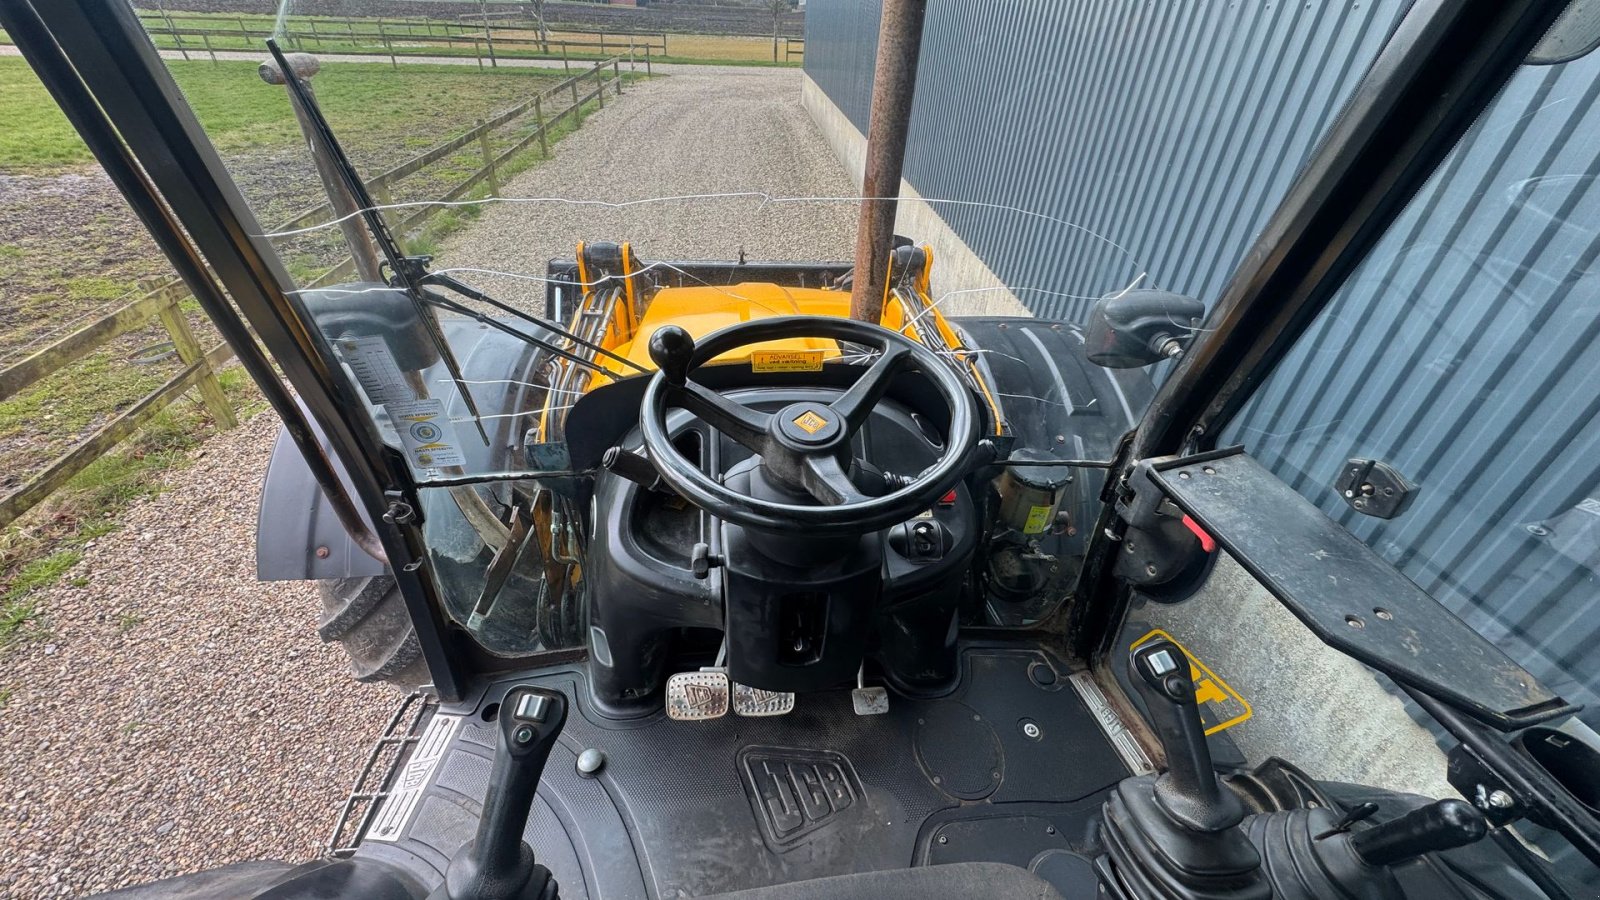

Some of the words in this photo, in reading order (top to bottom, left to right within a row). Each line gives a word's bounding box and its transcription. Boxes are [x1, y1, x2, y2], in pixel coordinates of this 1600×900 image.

[686, 686, 710, 707] JCB
[1102, 707, 1125, 735] JCB
[405, 762, 433, 788] JCB
[761, 759, 852, 833] JCB
